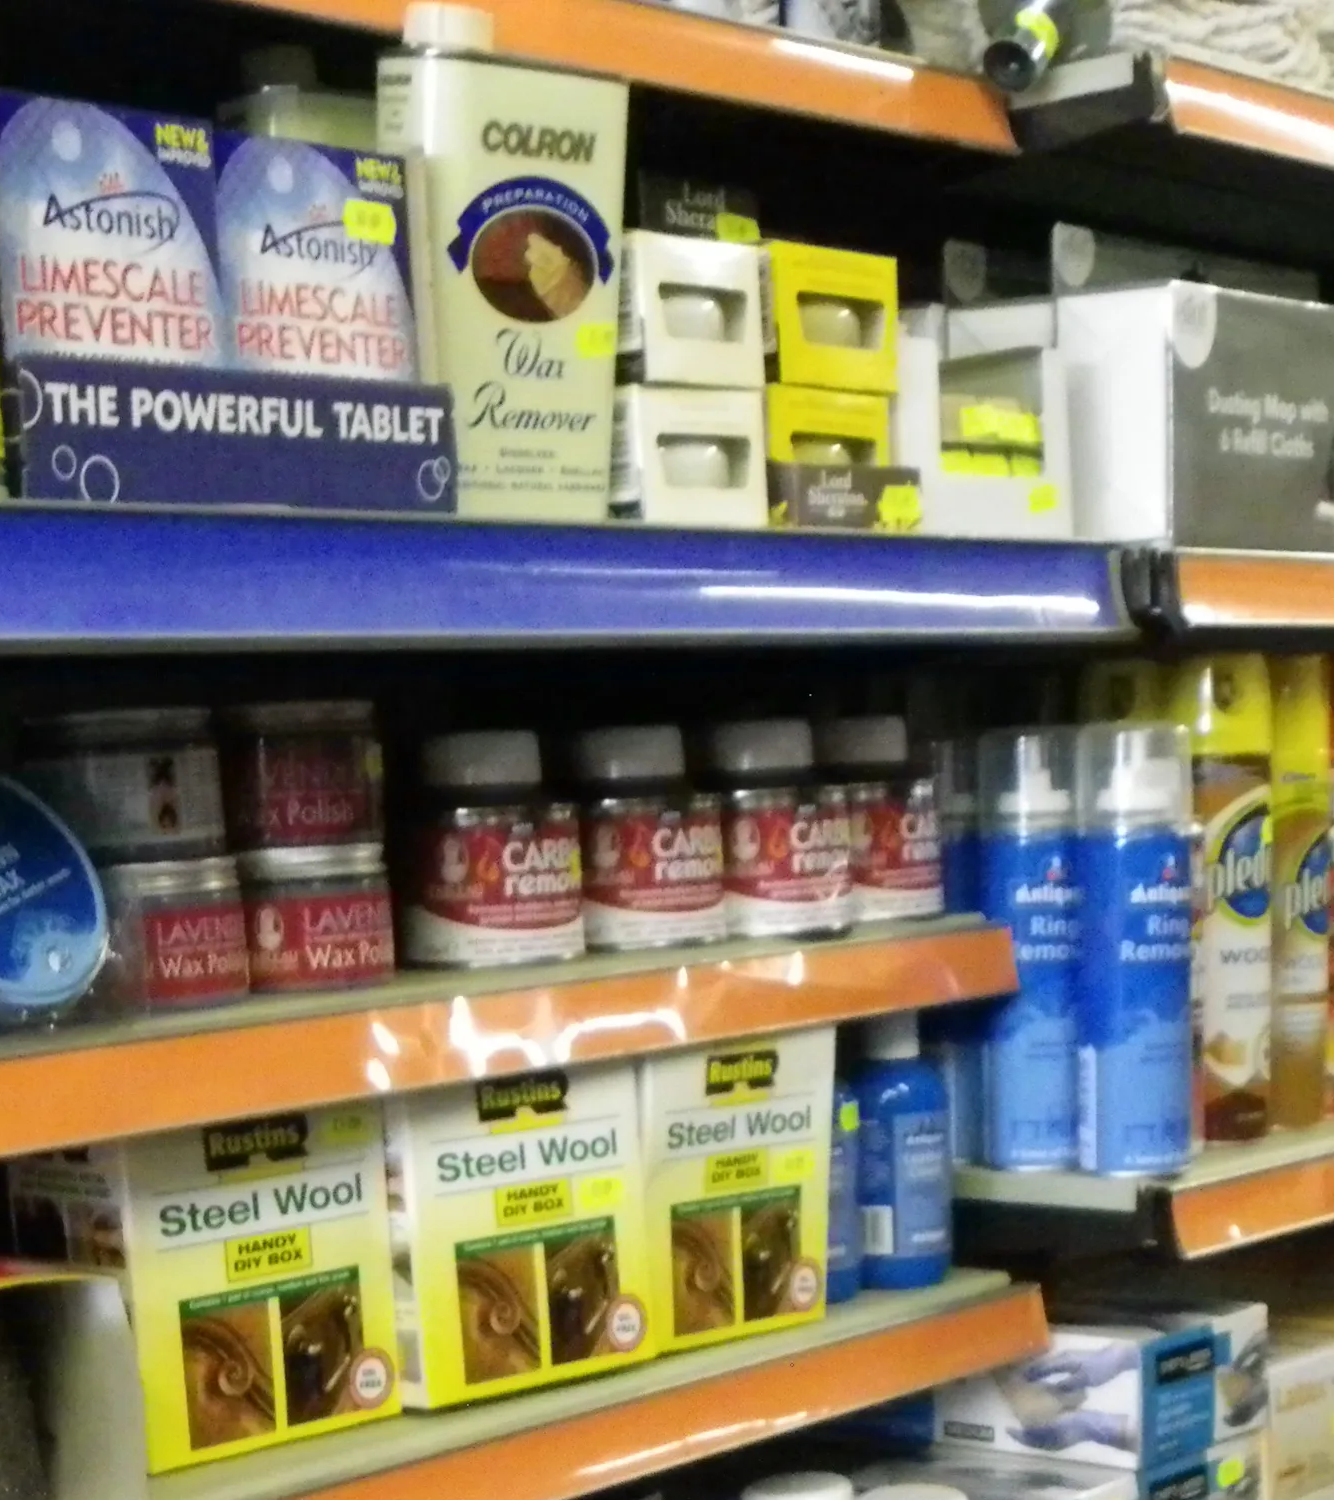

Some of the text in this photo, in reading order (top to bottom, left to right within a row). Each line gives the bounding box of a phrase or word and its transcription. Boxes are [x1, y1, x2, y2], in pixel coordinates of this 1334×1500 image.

[482, 120, 595, 162] COLRON
[42, 192, 178, 242] Astonish
[20, 256, 205, 307] LIMESCALE
[240, 278, 399, 328] LIMESCALE
[16, 301, 215, 351] PREVENTER
[237, 323, 406, 371] PREVENTER
[496, 326, 565, 378] Wax
[44, 383, 445, 444] THE POWERFUL TABLET
[468, 380, 596, 437] Remover
[159, 952, 202, 977] Wax
[306, 943, 355, 970] Wax
[708, 1056, 773, 1083] Rustins
[481, 1080, 562, 1109] Rustins
[208, 1122, 299, 1158] Rustins
[668, 1104, 812, 1150] Steel Wool
[437, 1128, 618, 1183] Steel Wool
[158, 1173, 364, 1238] Steel Wool
[506, 1182, 560, 1203] HANDY
[534, 1196, 565, 1215] BOX
[233, 1248, 304, 1274] DIY BOX
[237, 1232, 298, 1257] HANDY
